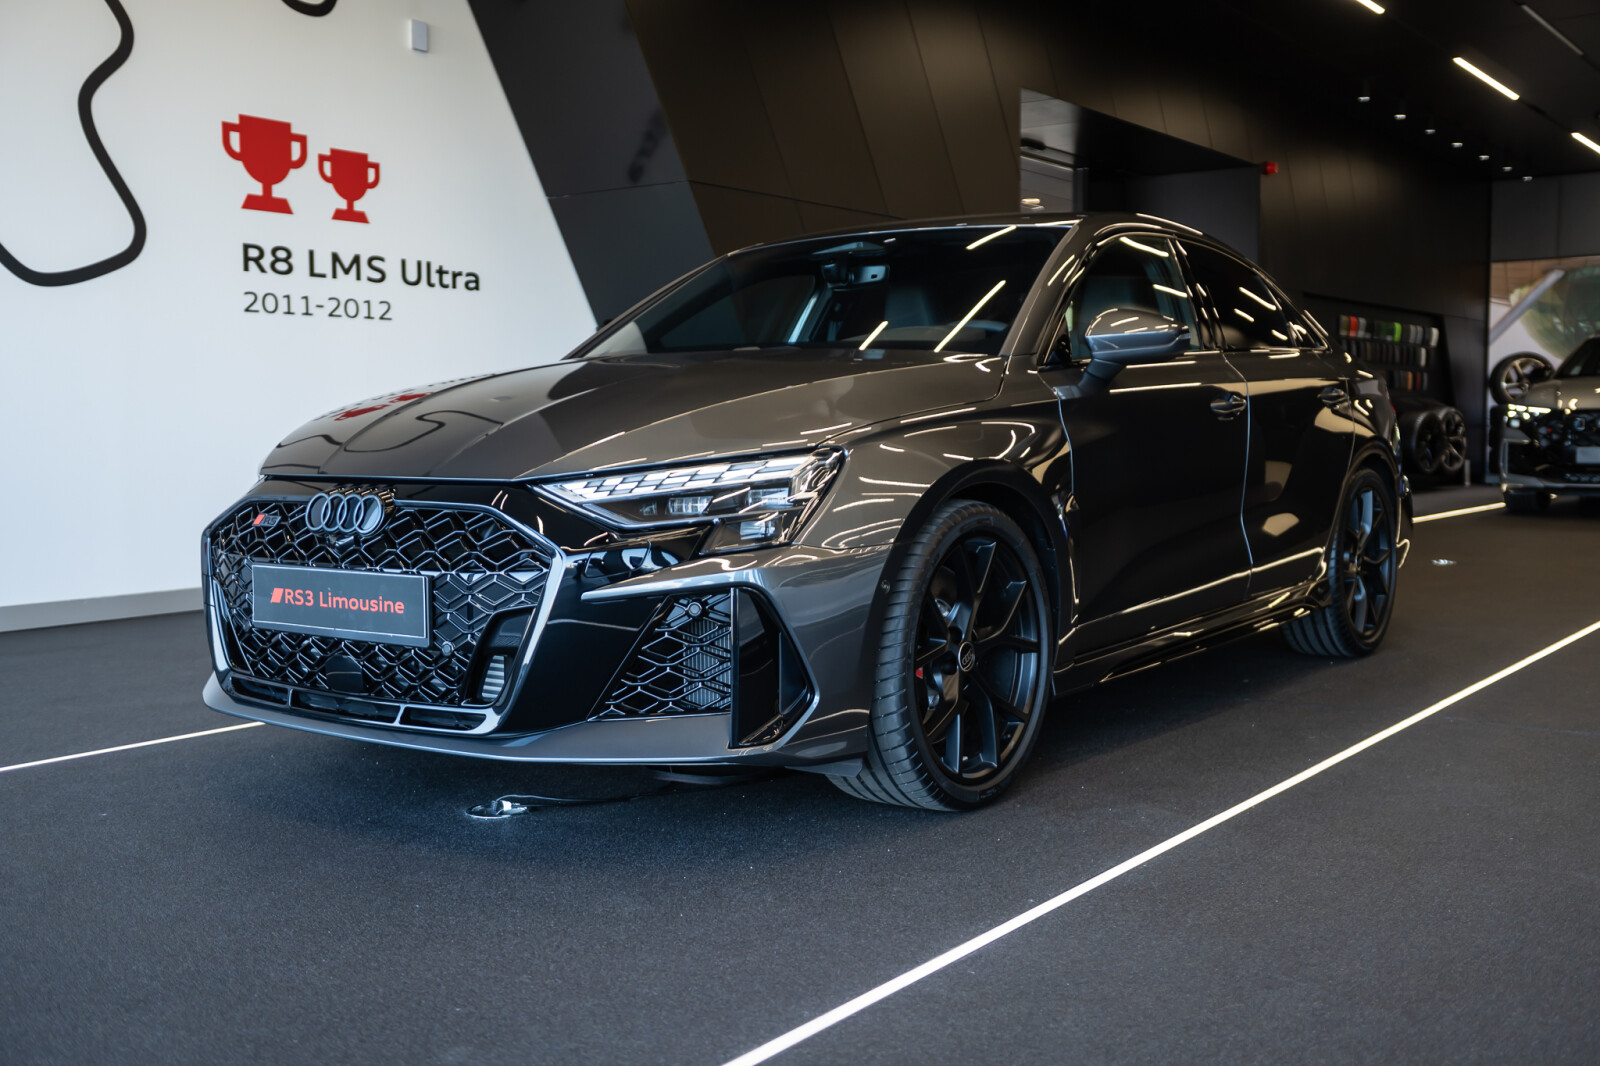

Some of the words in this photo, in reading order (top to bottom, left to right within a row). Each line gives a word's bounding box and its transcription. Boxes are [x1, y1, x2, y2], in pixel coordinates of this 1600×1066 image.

[242, 242, 294, 276] R8
[308, 249, 387, 284] LMS
[400, 258, 481, 292] Ultra
[244, 291, 392, 321] 2011-2012
[262, 515, 277, 525] RS
[284, 588, 314, 607] RS3
[319, 591, 405, 614] Limousine
